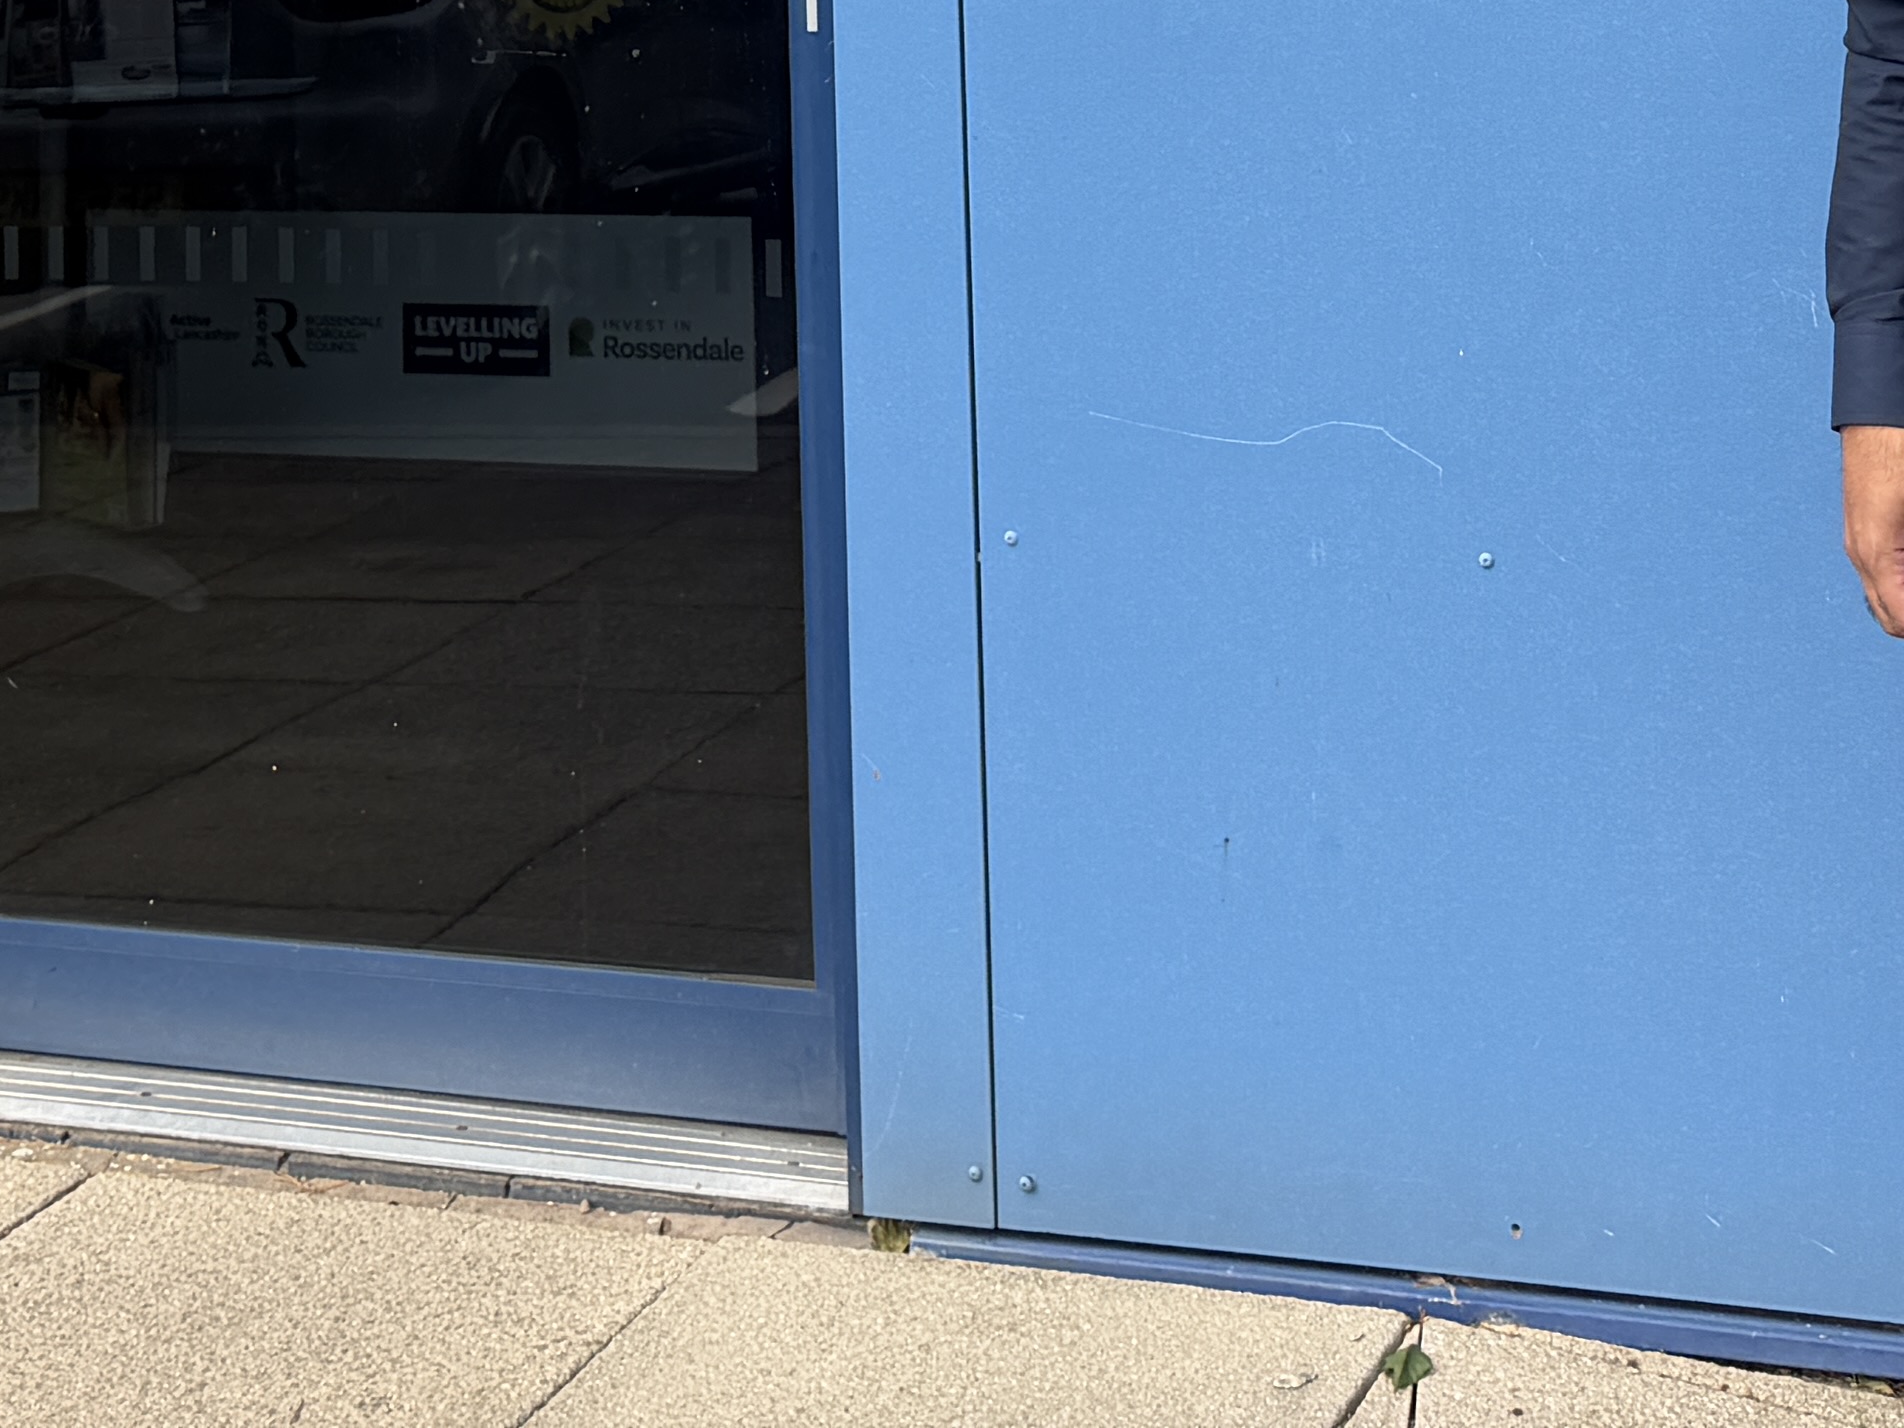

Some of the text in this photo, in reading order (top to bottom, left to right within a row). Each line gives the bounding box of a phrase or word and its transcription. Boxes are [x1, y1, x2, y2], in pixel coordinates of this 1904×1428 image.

[414, 316, 538, 339] LEVELLING
[602, 319, 692, 332] INVEST IN
[460, 343, 493, 363] UP
[604, 336, 744, 361] Rossendale
